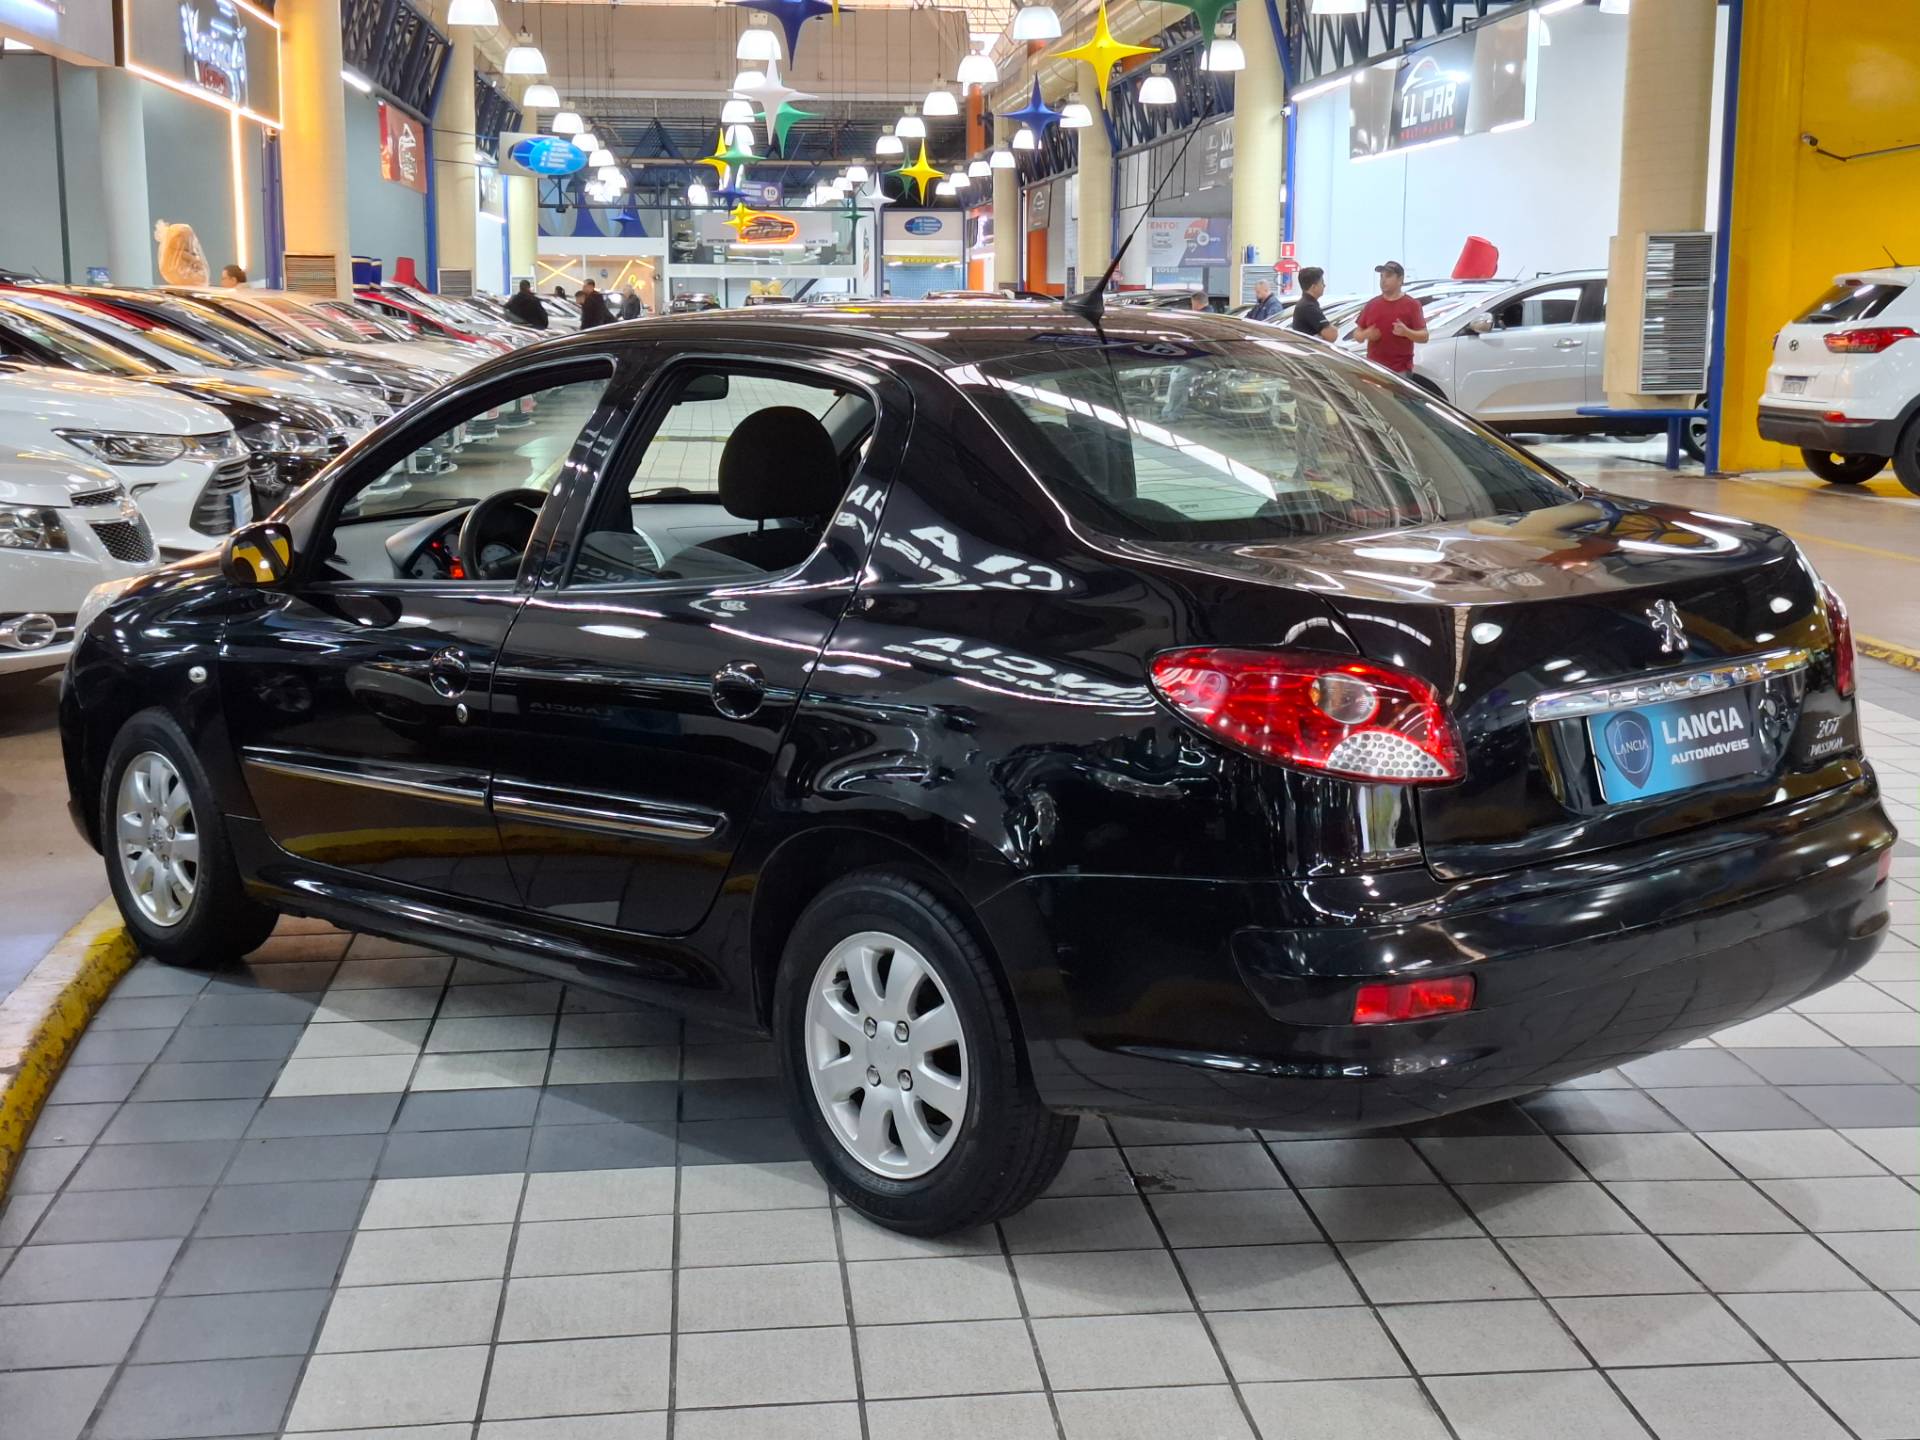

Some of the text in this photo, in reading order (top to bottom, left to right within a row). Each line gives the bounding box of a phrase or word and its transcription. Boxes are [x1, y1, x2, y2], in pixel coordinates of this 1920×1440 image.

[1401, 82, 1457, 129] LL CAR
[1661, 707, 1744, 744] LANCIA
[1816, 716, 1841, 739] 207
[1614, 739, 1649, 756] LANCIA
[1671, 738, 1750, 765] AUTOMÓVEIS
